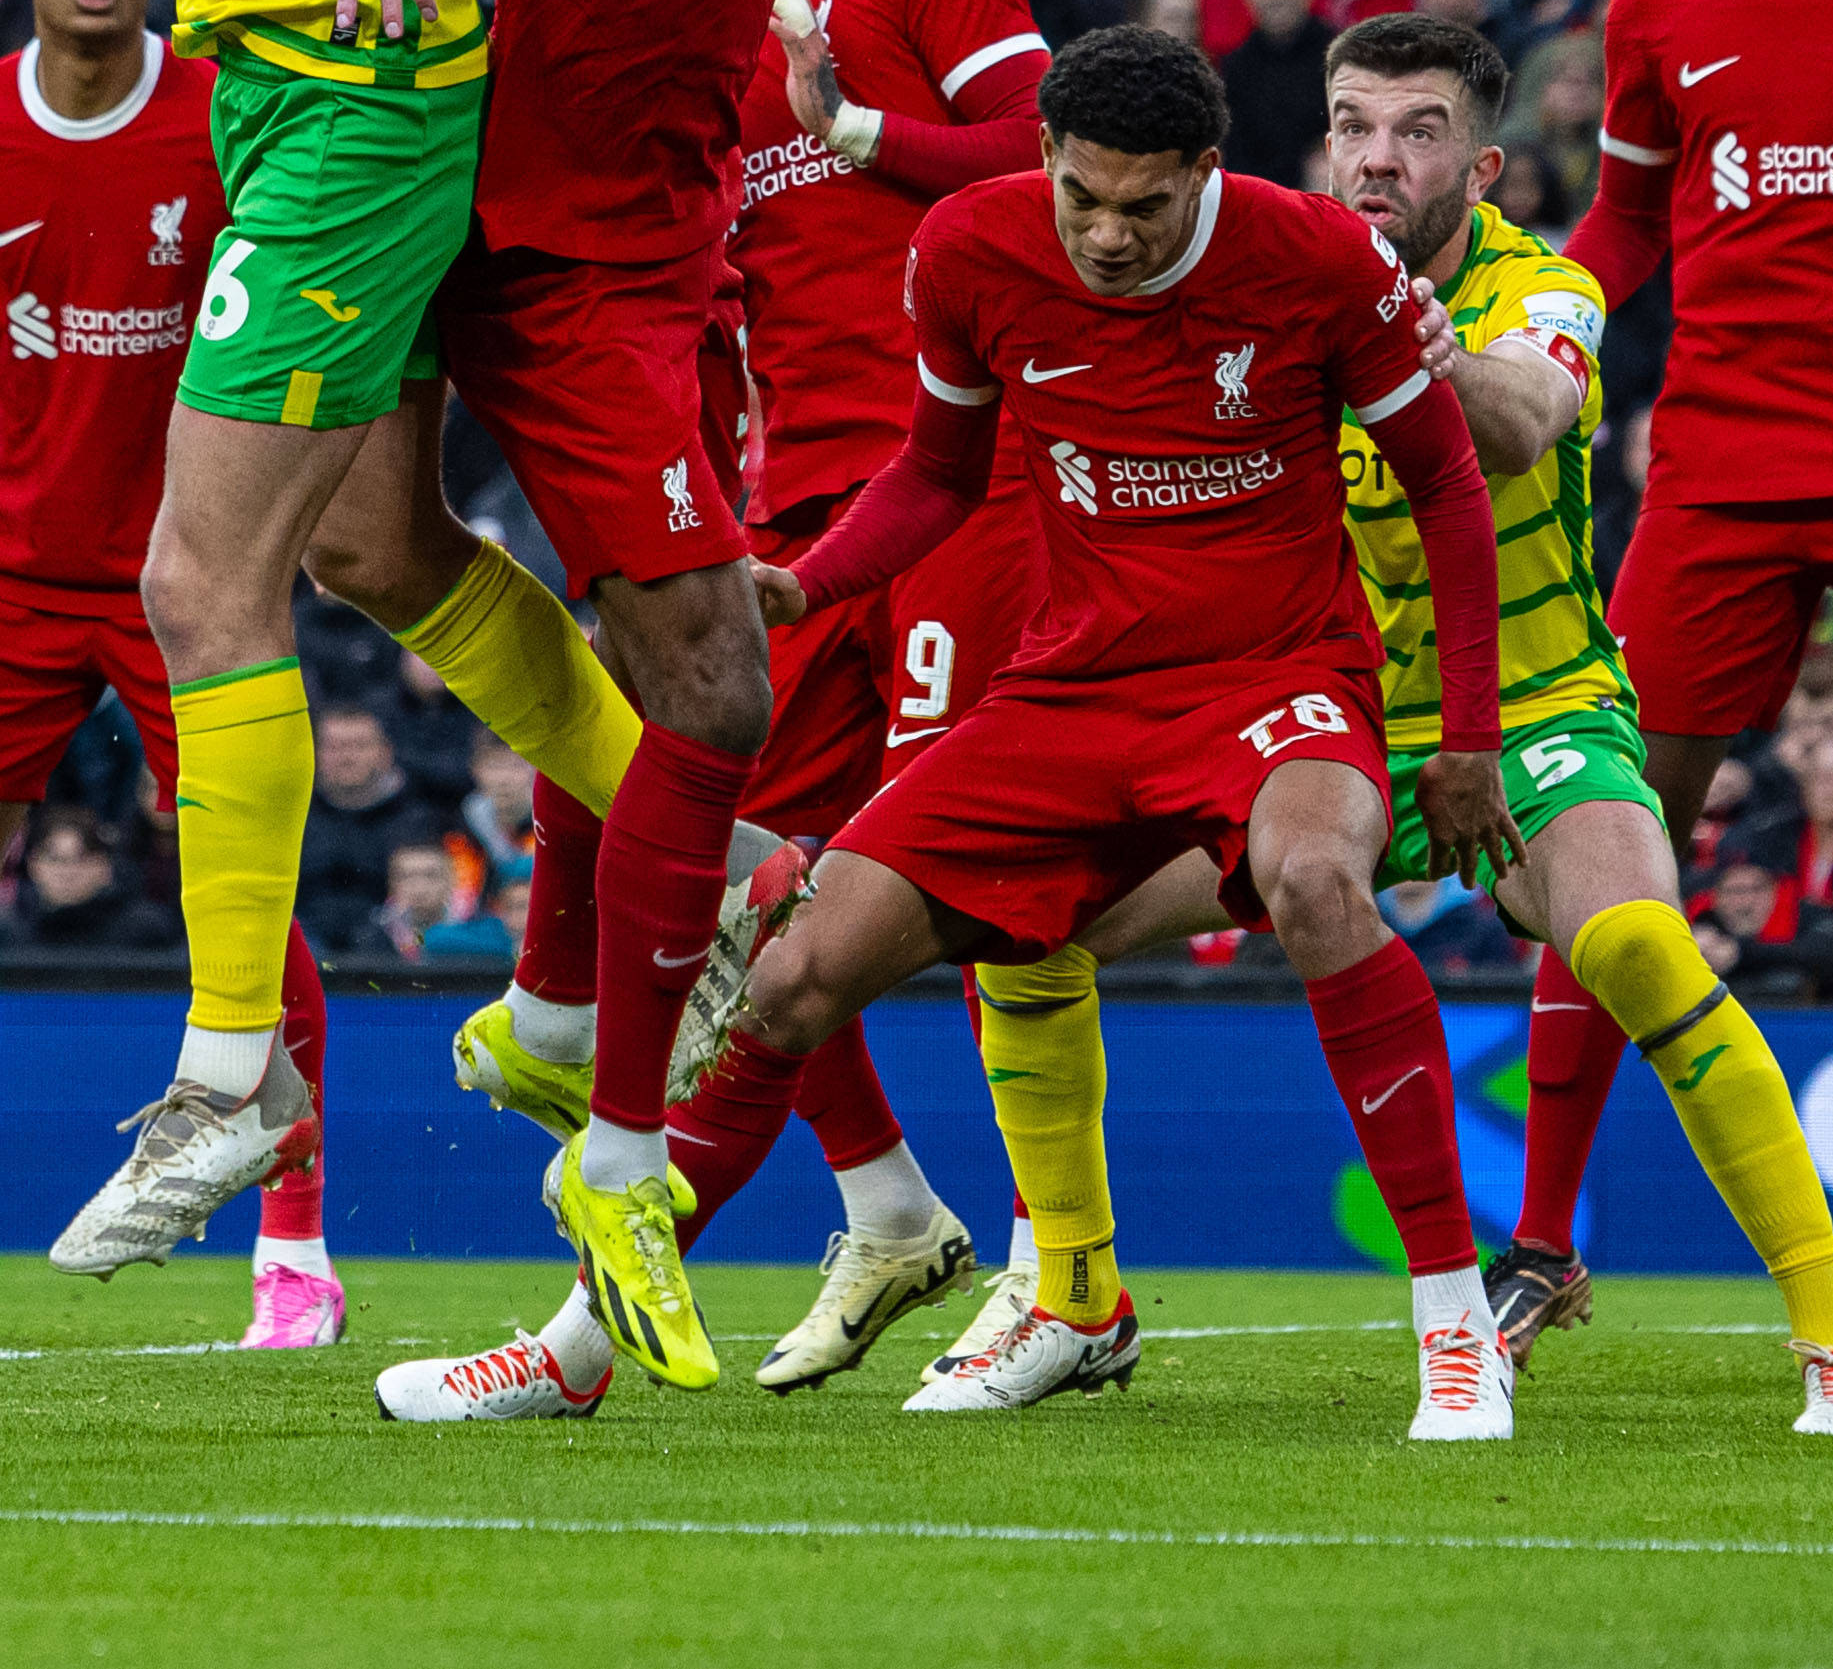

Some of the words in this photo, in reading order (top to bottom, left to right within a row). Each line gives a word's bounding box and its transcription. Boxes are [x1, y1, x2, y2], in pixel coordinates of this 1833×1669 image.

[740, 153, 868, 210] hartere
[741, 133, 828, 175] anda
[59, 302, 185, 332] standard
[199, 238, 257, 342] 6
[60, 325, 187, 357] chartered
[1107, 447, 1270, 482] standard
[899, 619, 956, 721] 9
[1519, 733, 1588, 793] 5
[1068, 1250, 1089, 1305] DESIGN
